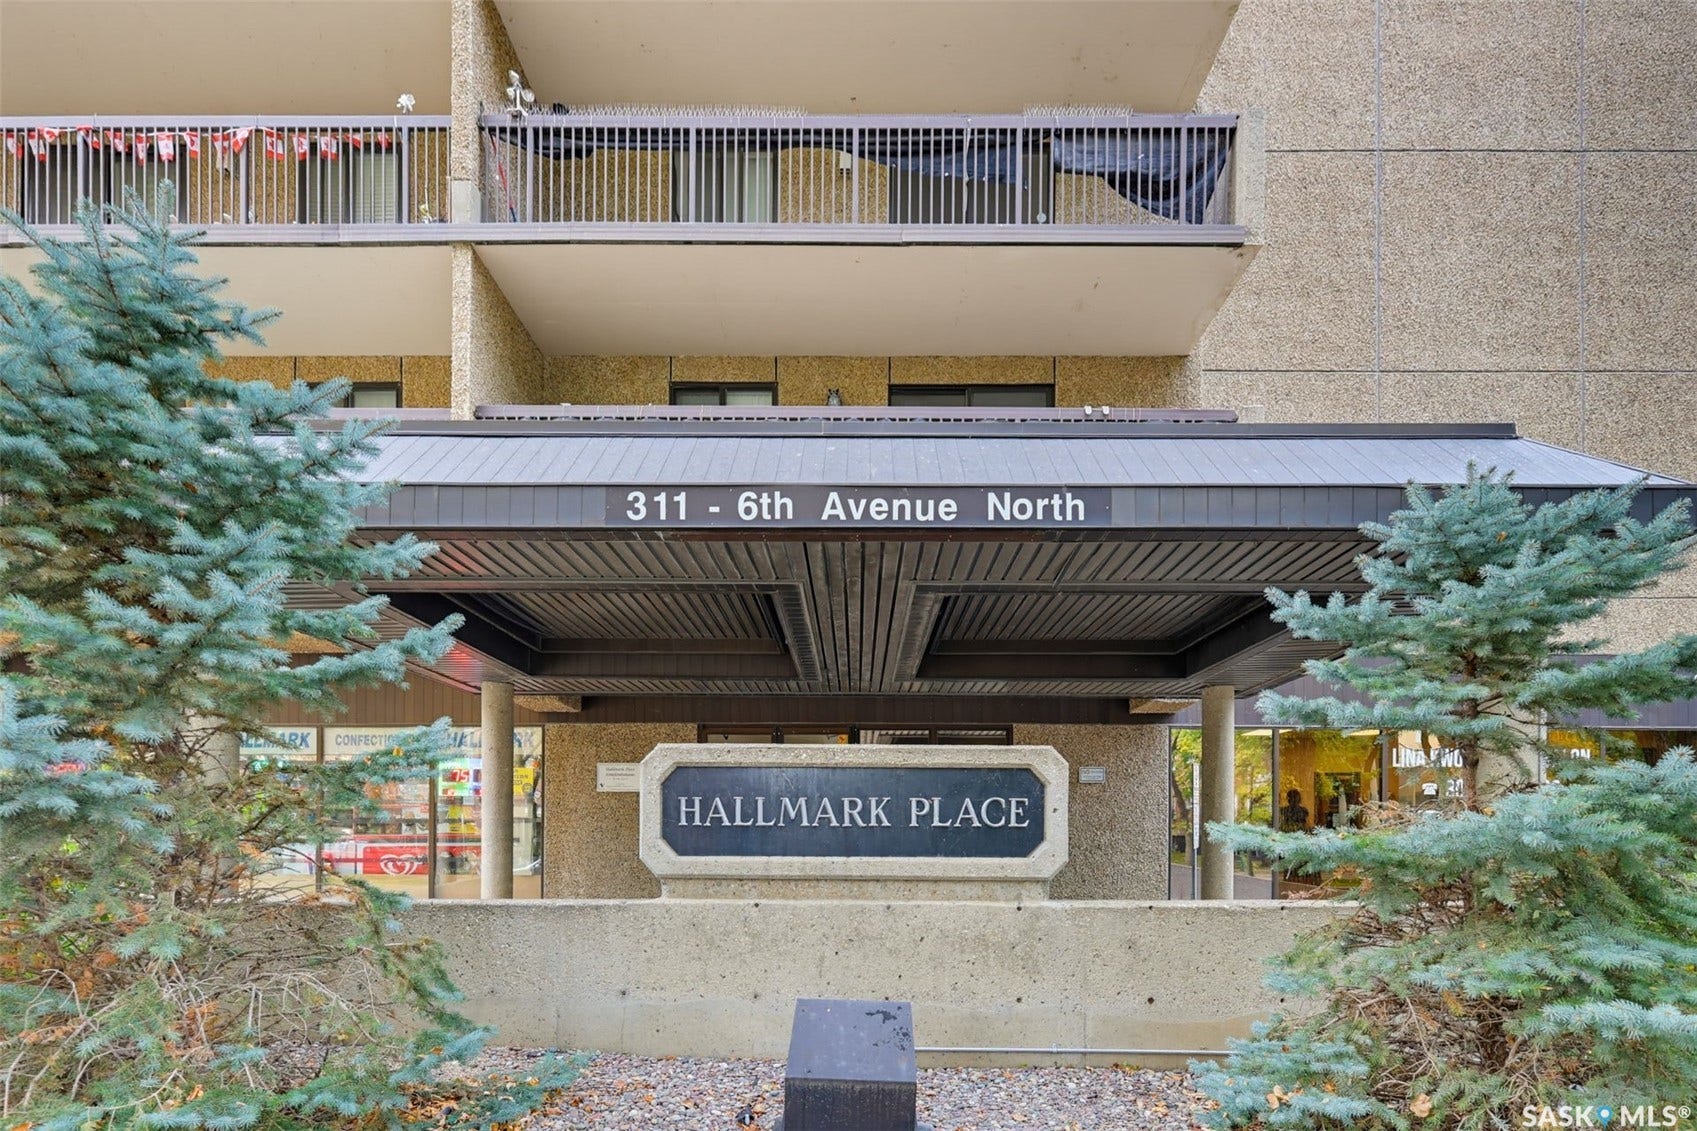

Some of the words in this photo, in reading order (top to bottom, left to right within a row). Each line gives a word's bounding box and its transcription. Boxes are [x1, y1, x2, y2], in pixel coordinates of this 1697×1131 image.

[626, 491, 687, 521] 311
[737, 491, 793, 521] 6th
[821, 492, 958, 521] Avenue
[987, 491, 1085, 521] North
[1392, 748, 1426, 767] LINA
[678, 796, 892, 827] HALLMARK
[908, 796, 1031, 827] PLACE
